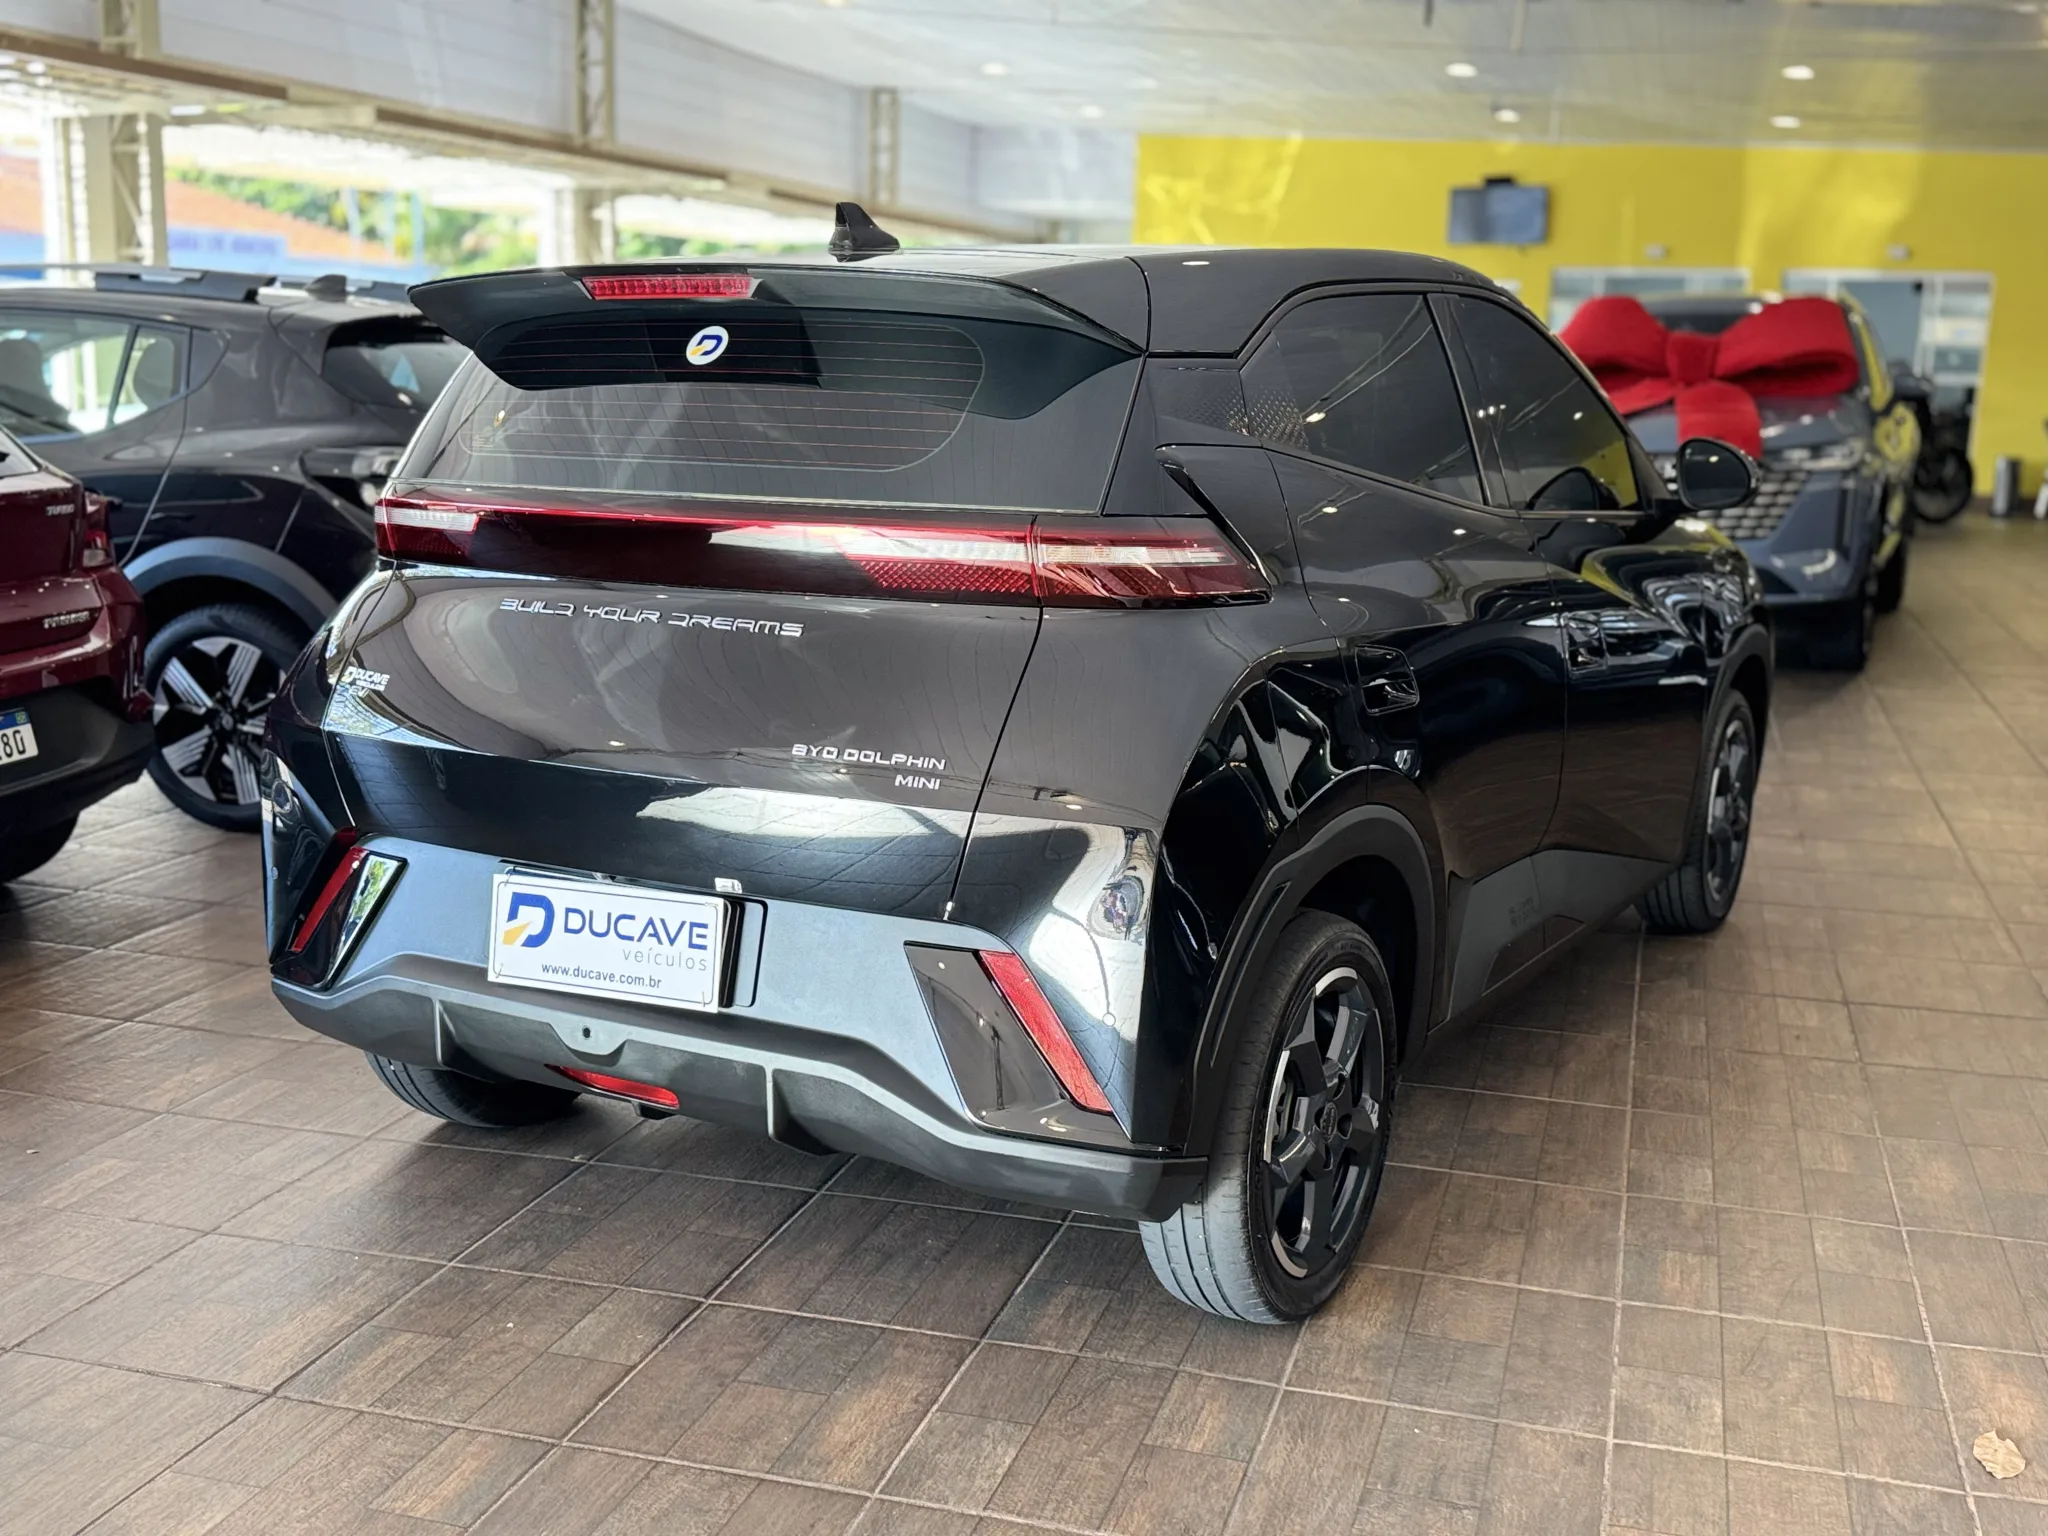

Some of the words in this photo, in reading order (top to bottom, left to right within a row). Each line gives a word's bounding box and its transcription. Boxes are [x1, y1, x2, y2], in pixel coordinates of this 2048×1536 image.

[499, 597, 576, 617] BUILD
[583, 604, 662, 624] YOUR
[668, 612, 805, 638] DREAMS
[791, 743, 839, 759] BYD
[843, 748, 947, 770] DOLPHIN
[894, 774, 941, 790] MINI
[563, 907, 709, 951] DUCAVE
[622, 947, 708, 972] veículos
[541, 963, 662, 989] www.ducave.com.br
